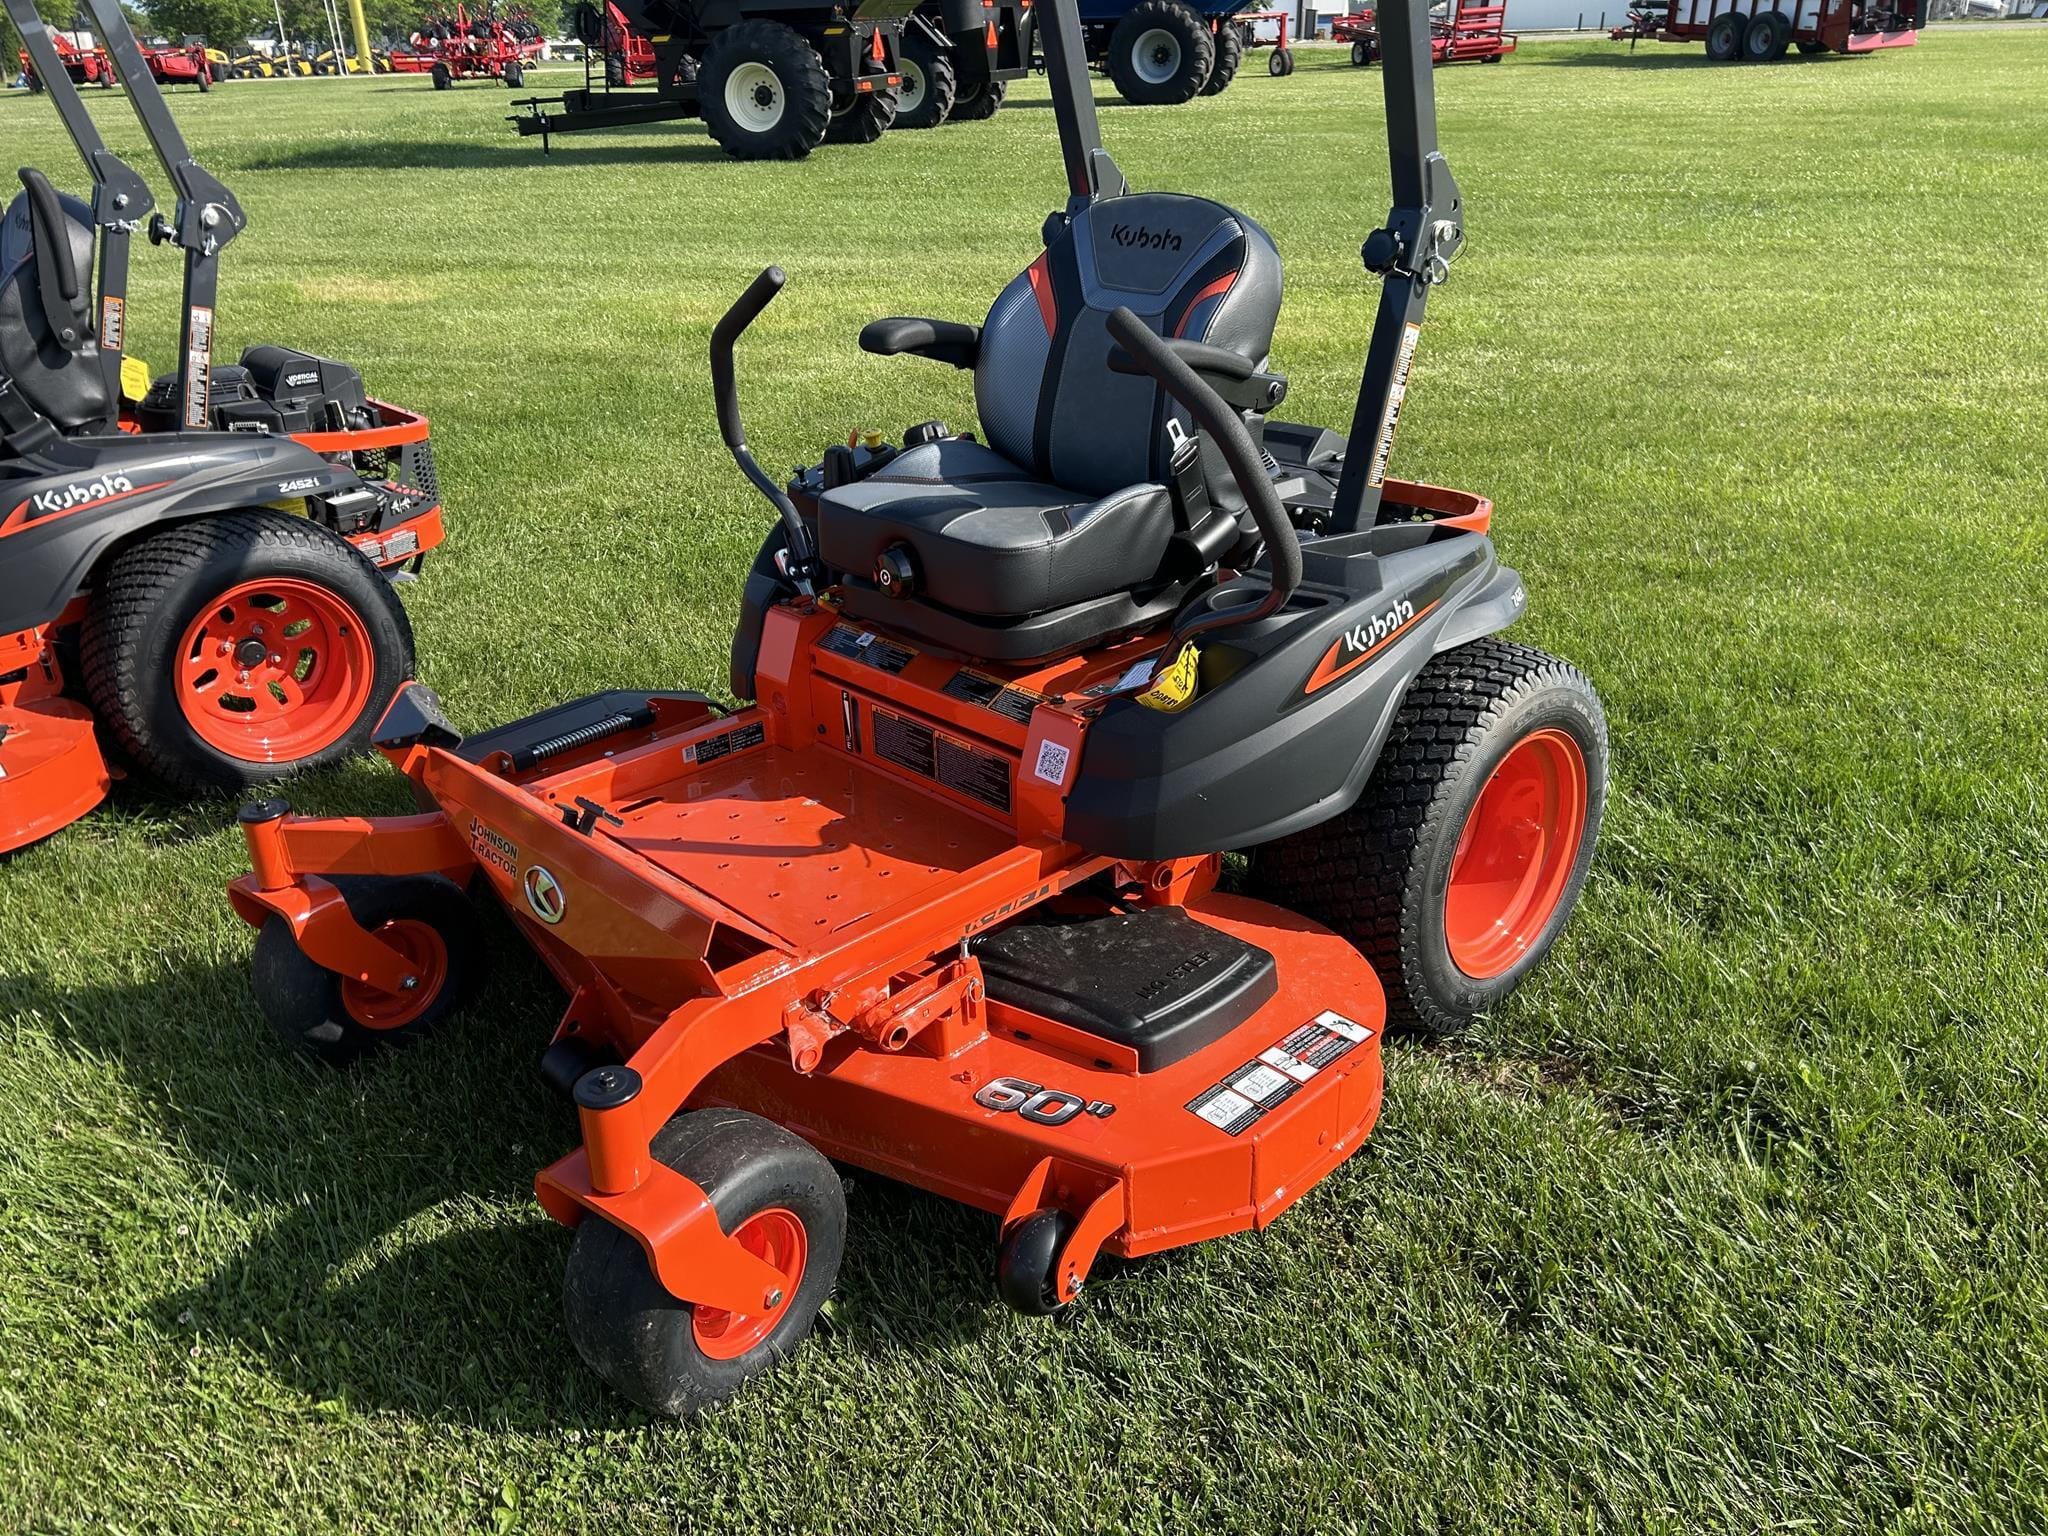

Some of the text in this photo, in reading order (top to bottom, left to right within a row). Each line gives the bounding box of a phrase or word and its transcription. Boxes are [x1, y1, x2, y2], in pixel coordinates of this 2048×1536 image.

[1111, 223, 1182, 251] Kubota
[33, 472, 133, 513] Kubota
[1345, 599, 1414, 652] Kubota
[470, 817, 518, 859] JOHNSON
[471, 832, 518, 878] TRACTOR
[1166, 951, 1213, 980] STEP
